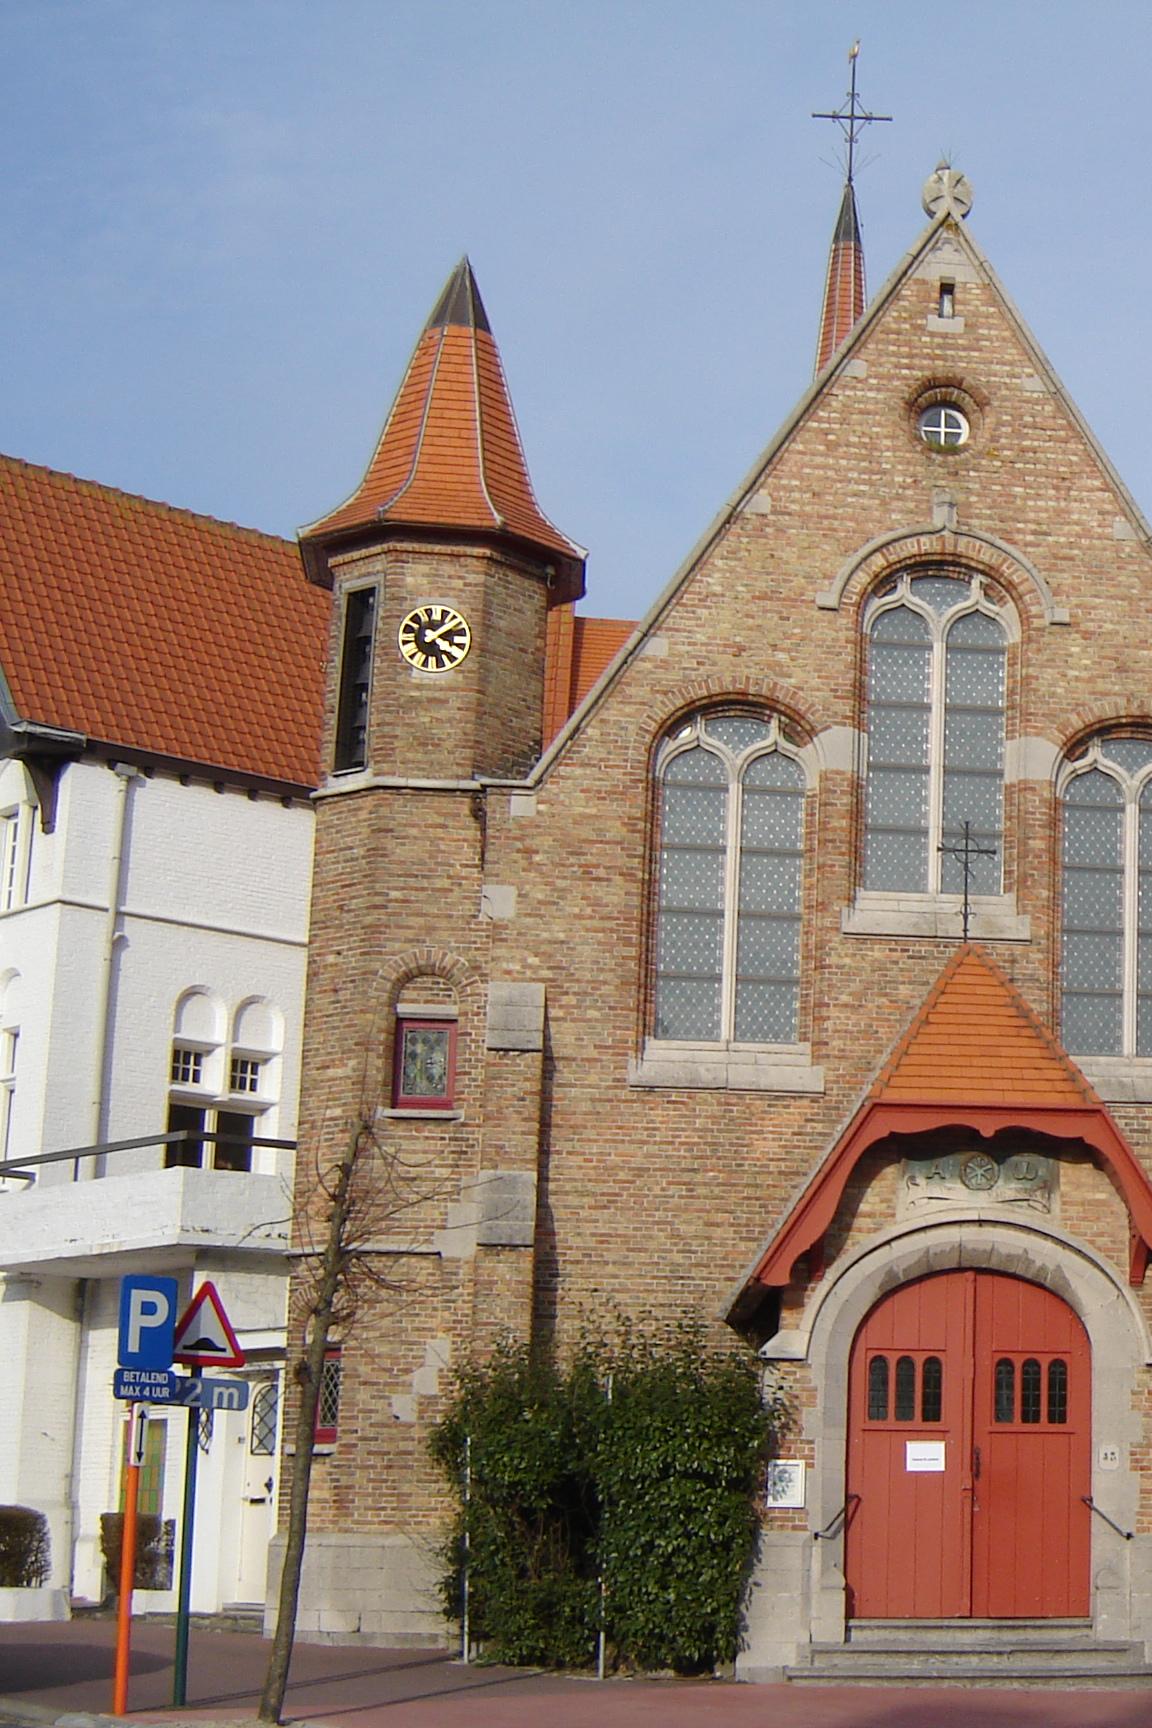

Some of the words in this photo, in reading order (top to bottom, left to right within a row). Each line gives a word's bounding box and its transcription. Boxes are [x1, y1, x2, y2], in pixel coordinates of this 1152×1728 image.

[128, 1288, 169, 1353] P
[123, 1371, 168, 1383] BETALEND
[119, 1385, 140, 1396] MAX
[143, 1386, 149, 1397] 4
[151, 1387, 170, 1398] UUR
[212, 1386, 239, 1409] m
